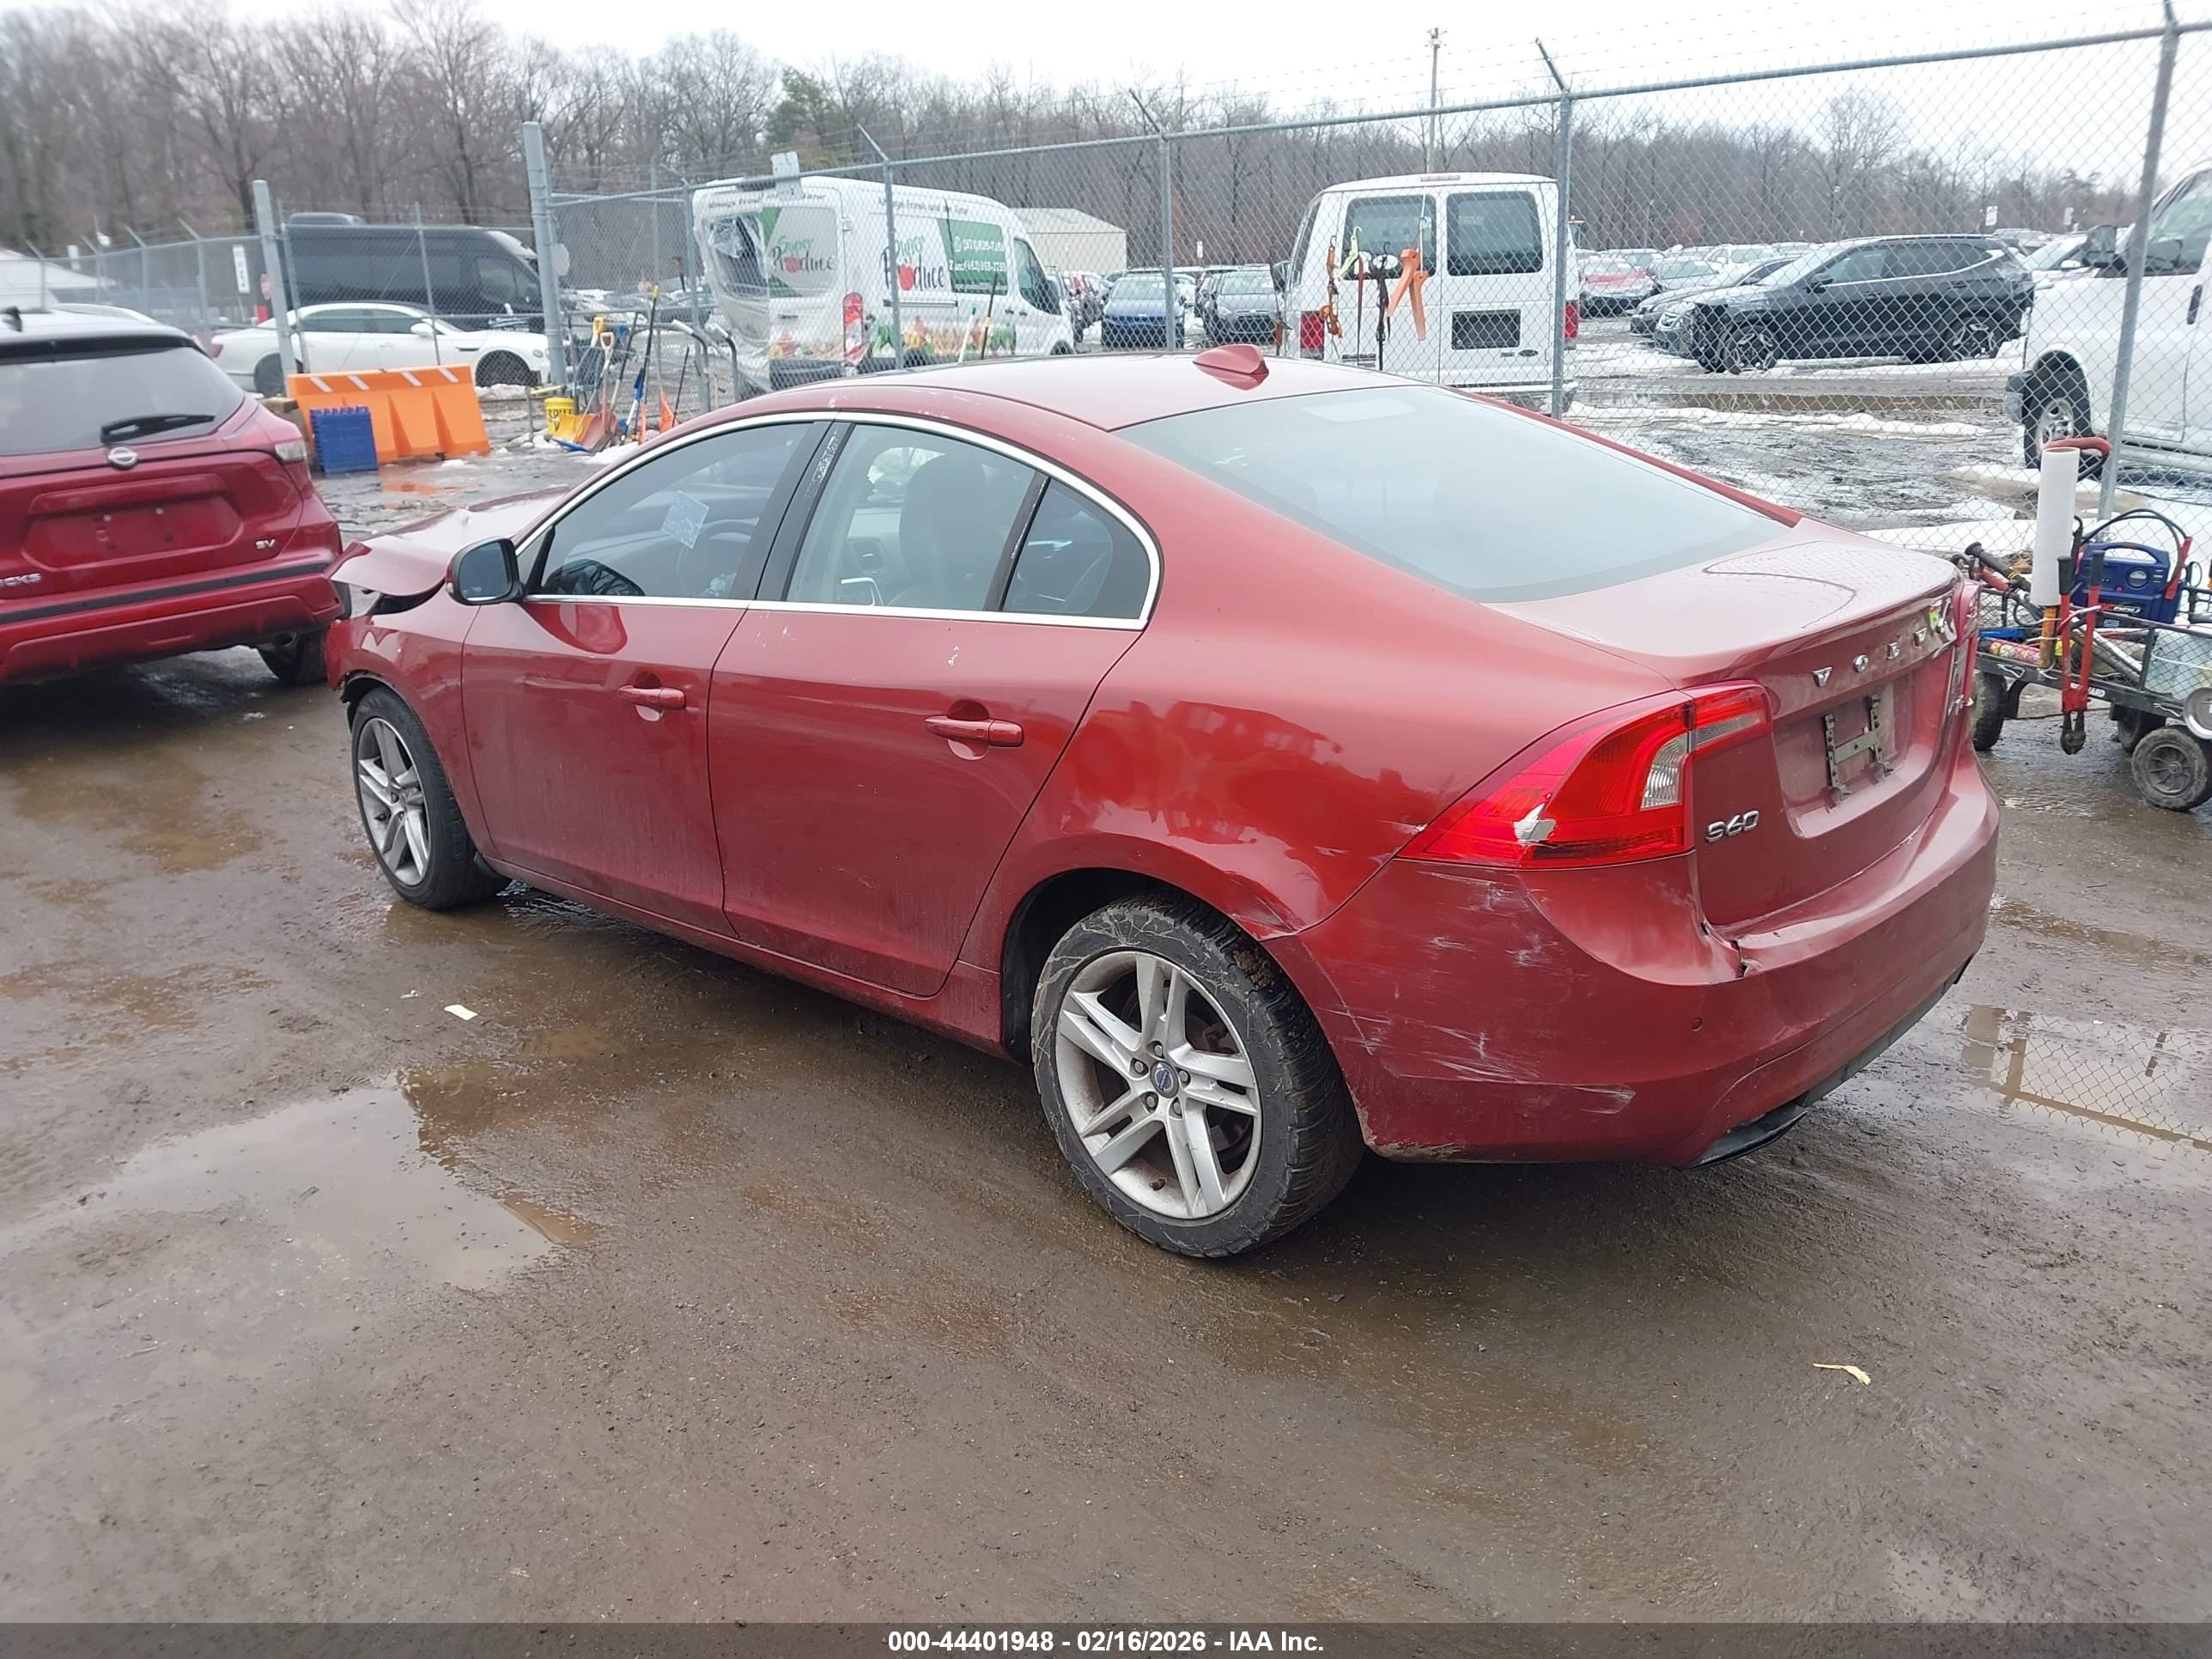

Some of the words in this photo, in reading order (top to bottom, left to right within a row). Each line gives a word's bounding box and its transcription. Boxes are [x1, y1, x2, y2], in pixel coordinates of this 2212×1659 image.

[778, 234, 815, 256] Super
[768, 245, 836, 274] Produce
[879, 246, 945, 291] Poduce
[255, 538, 276, 550] SV
[0, 573, 42, 587] ICKS
[1705, 810, 1760, 844] S60
